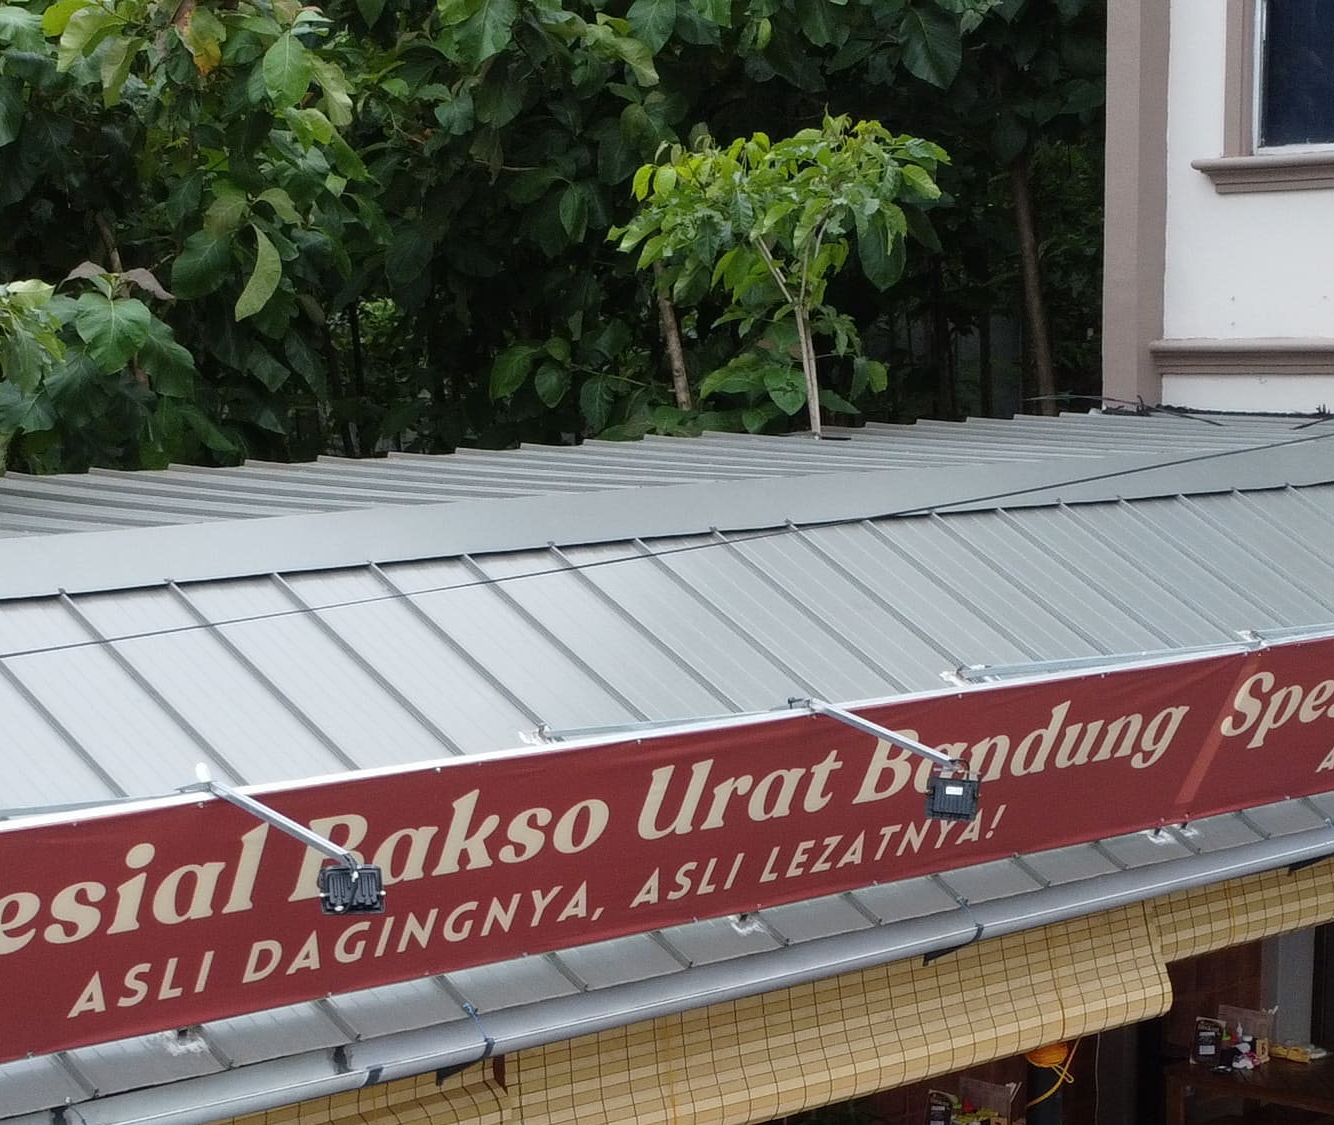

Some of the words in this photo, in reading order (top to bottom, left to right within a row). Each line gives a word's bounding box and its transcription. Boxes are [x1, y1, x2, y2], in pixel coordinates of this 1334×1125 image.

[287, 788, 611, 903] Bakso
[637, 749, 844, 842] Urat
[852, 700, 1190, 804] Bandung
[66, 951, 215, 1018] ASLI
[243, 881, 605, 984] DAGINGNYA,
[629, 853, 745, 908] ASLI
[760, 804, 1007, 884] LEZATNYA!
